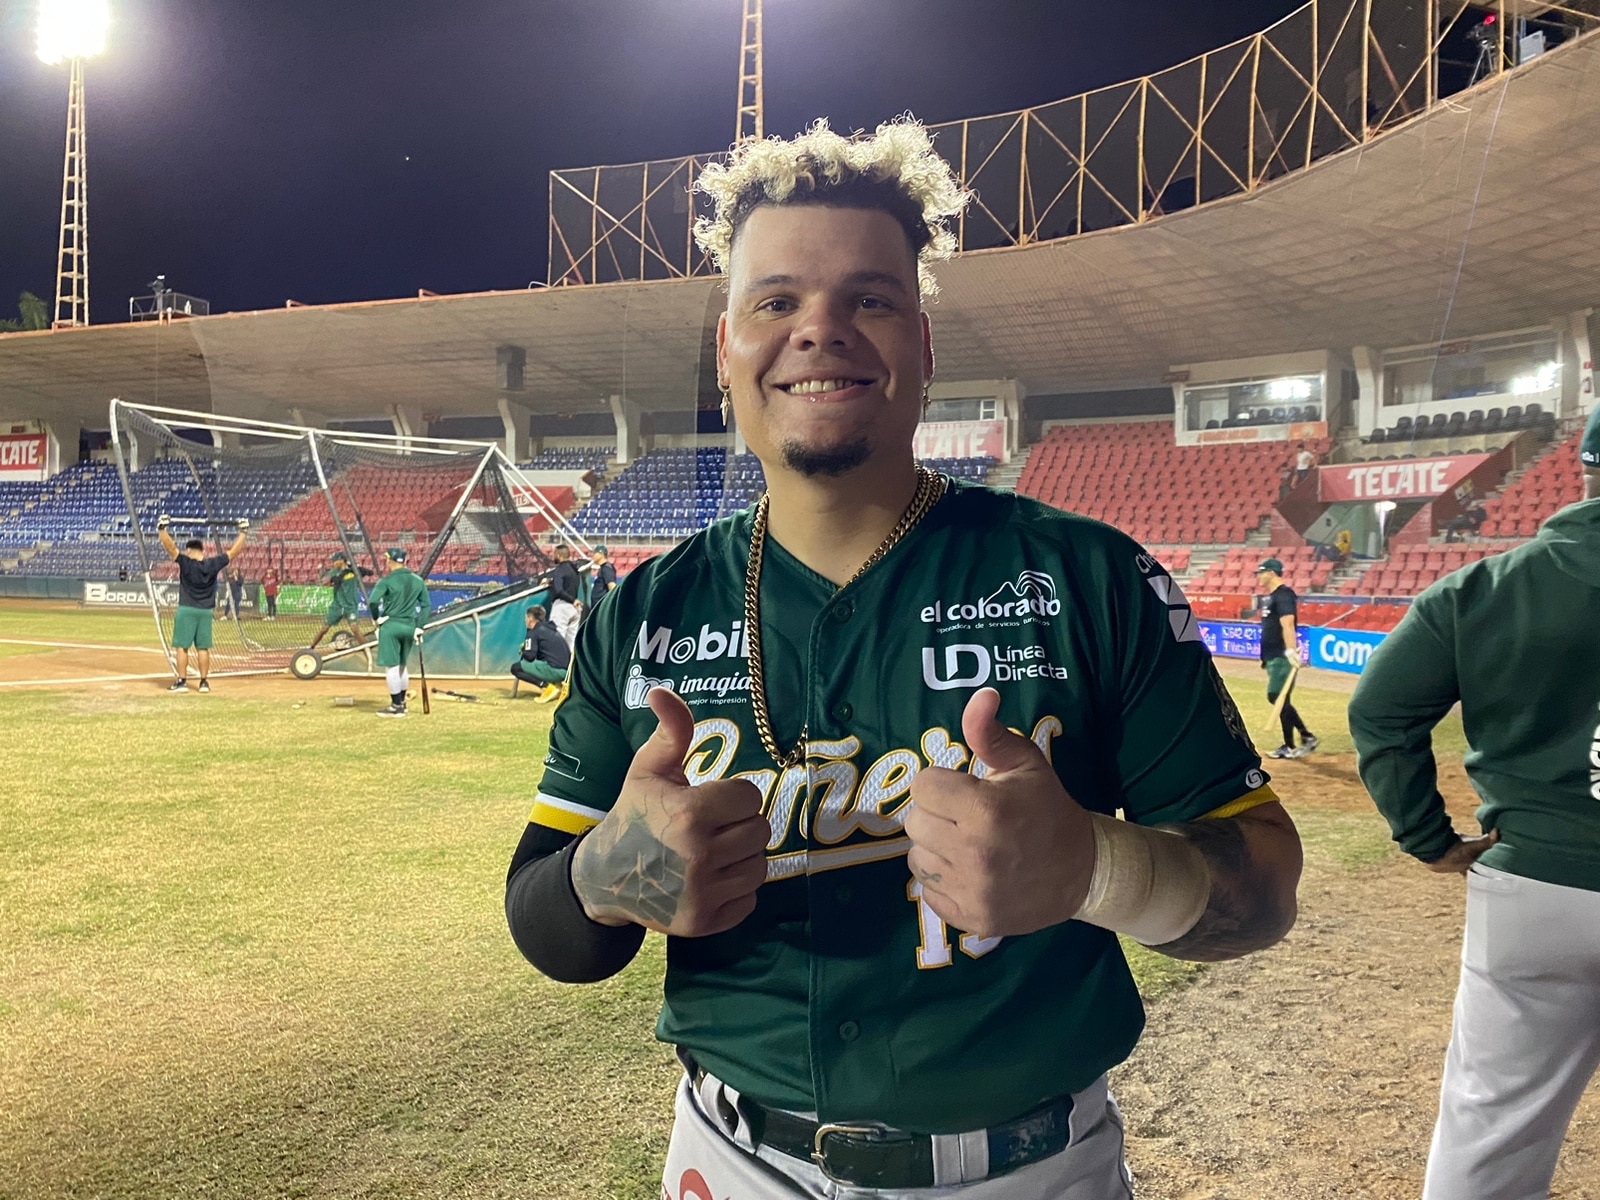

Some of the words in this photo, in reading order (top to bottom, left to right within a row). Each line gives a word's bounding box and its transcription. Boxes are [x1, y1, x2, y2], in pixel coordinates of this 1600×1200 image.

[0, 440, 40, 465] CATE
[1347, 461, 1455, 498] TECATE
[920, 600, 942, 623] el
[946, 595, 1062, 621] colorado
[975, 622, 984, 630] de
[631, 620, 750, 664] Mobil
[993, 645, 1046, 663] Línea
[1319, 633, 1378, 668] Com
[994, 662, 1069, 682] Directa
[709, 696, 748, 706] impresión
[907, 876, 1003, 970] 1
